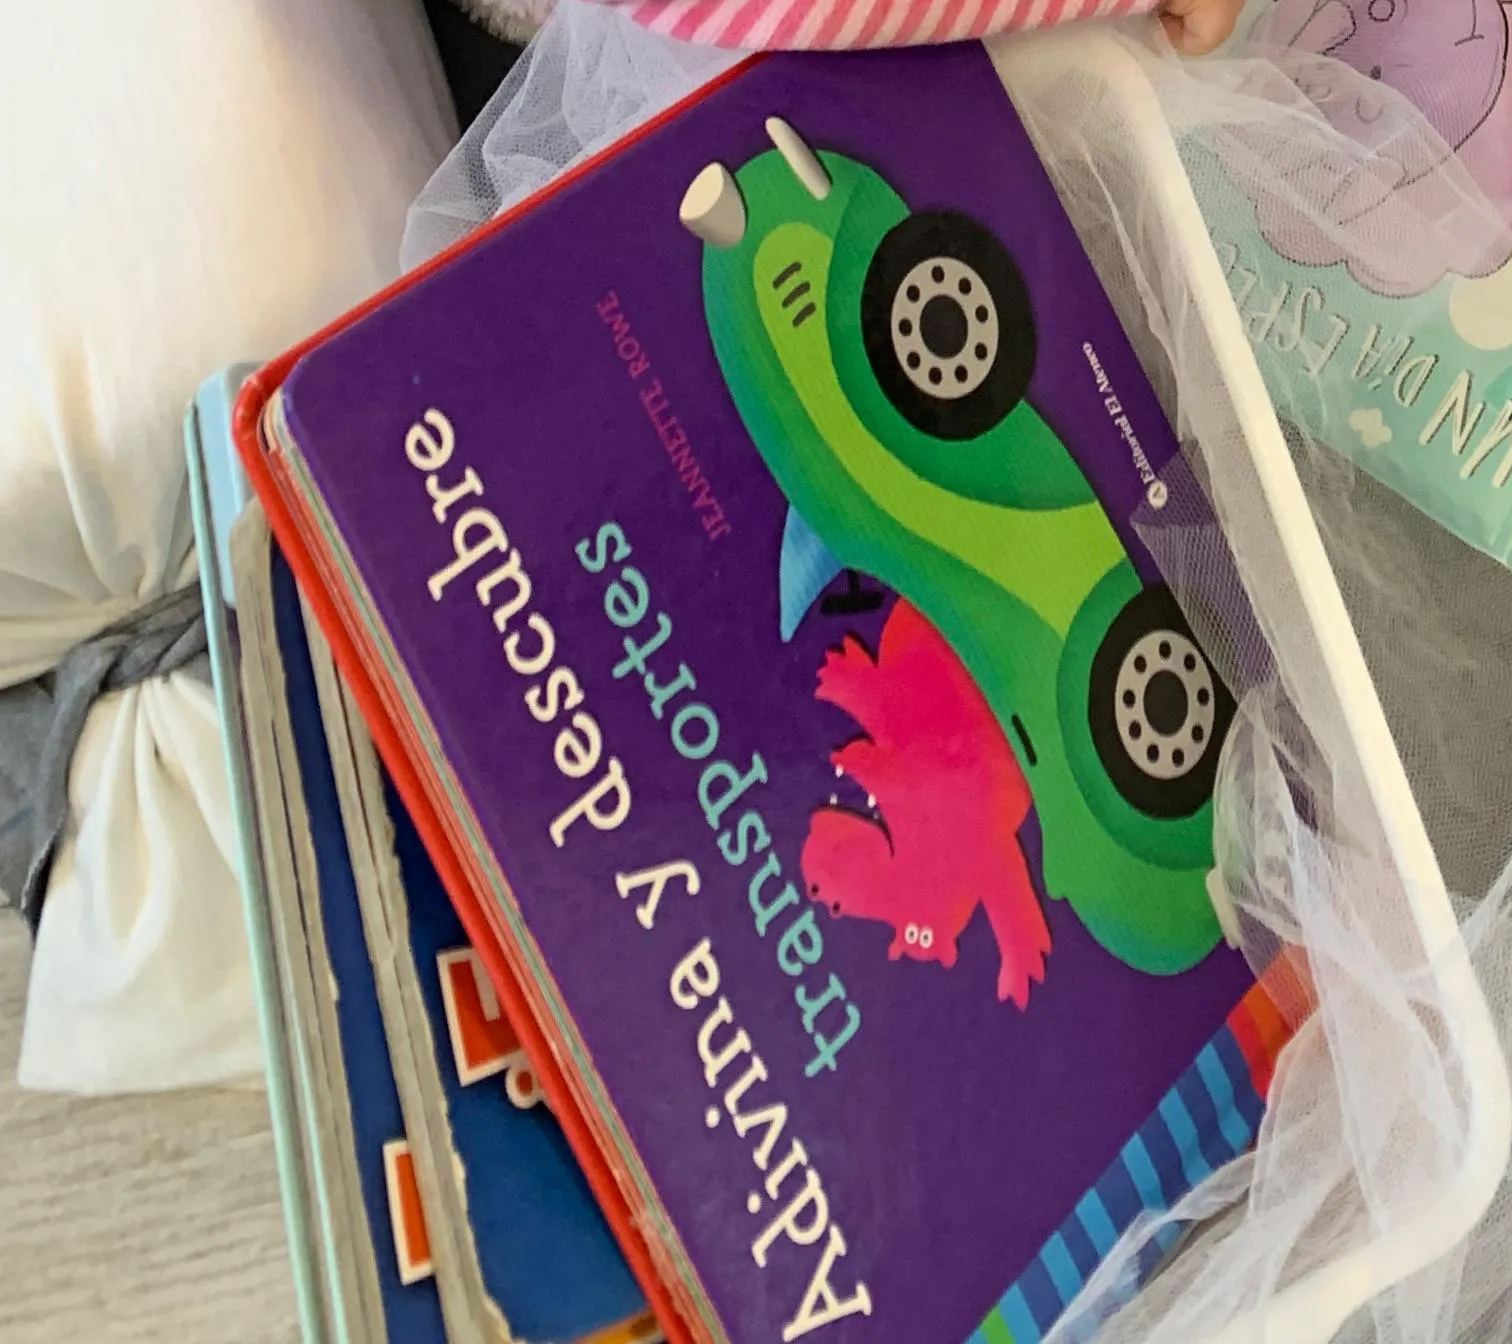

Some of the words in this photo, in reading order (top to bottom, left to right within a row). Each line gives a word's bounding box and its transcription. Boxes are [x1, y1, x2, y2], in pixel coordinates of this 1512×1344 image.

[597, 289, 650, 379] ROWE
[639, 378, 733, 541] JEANNETTE
[404, 407, 631, 848] descubre
[575, 520, 863, 1079] transportes
[615, 856, 702, 930] y
[670, 938, 872, 1342] Adivina
